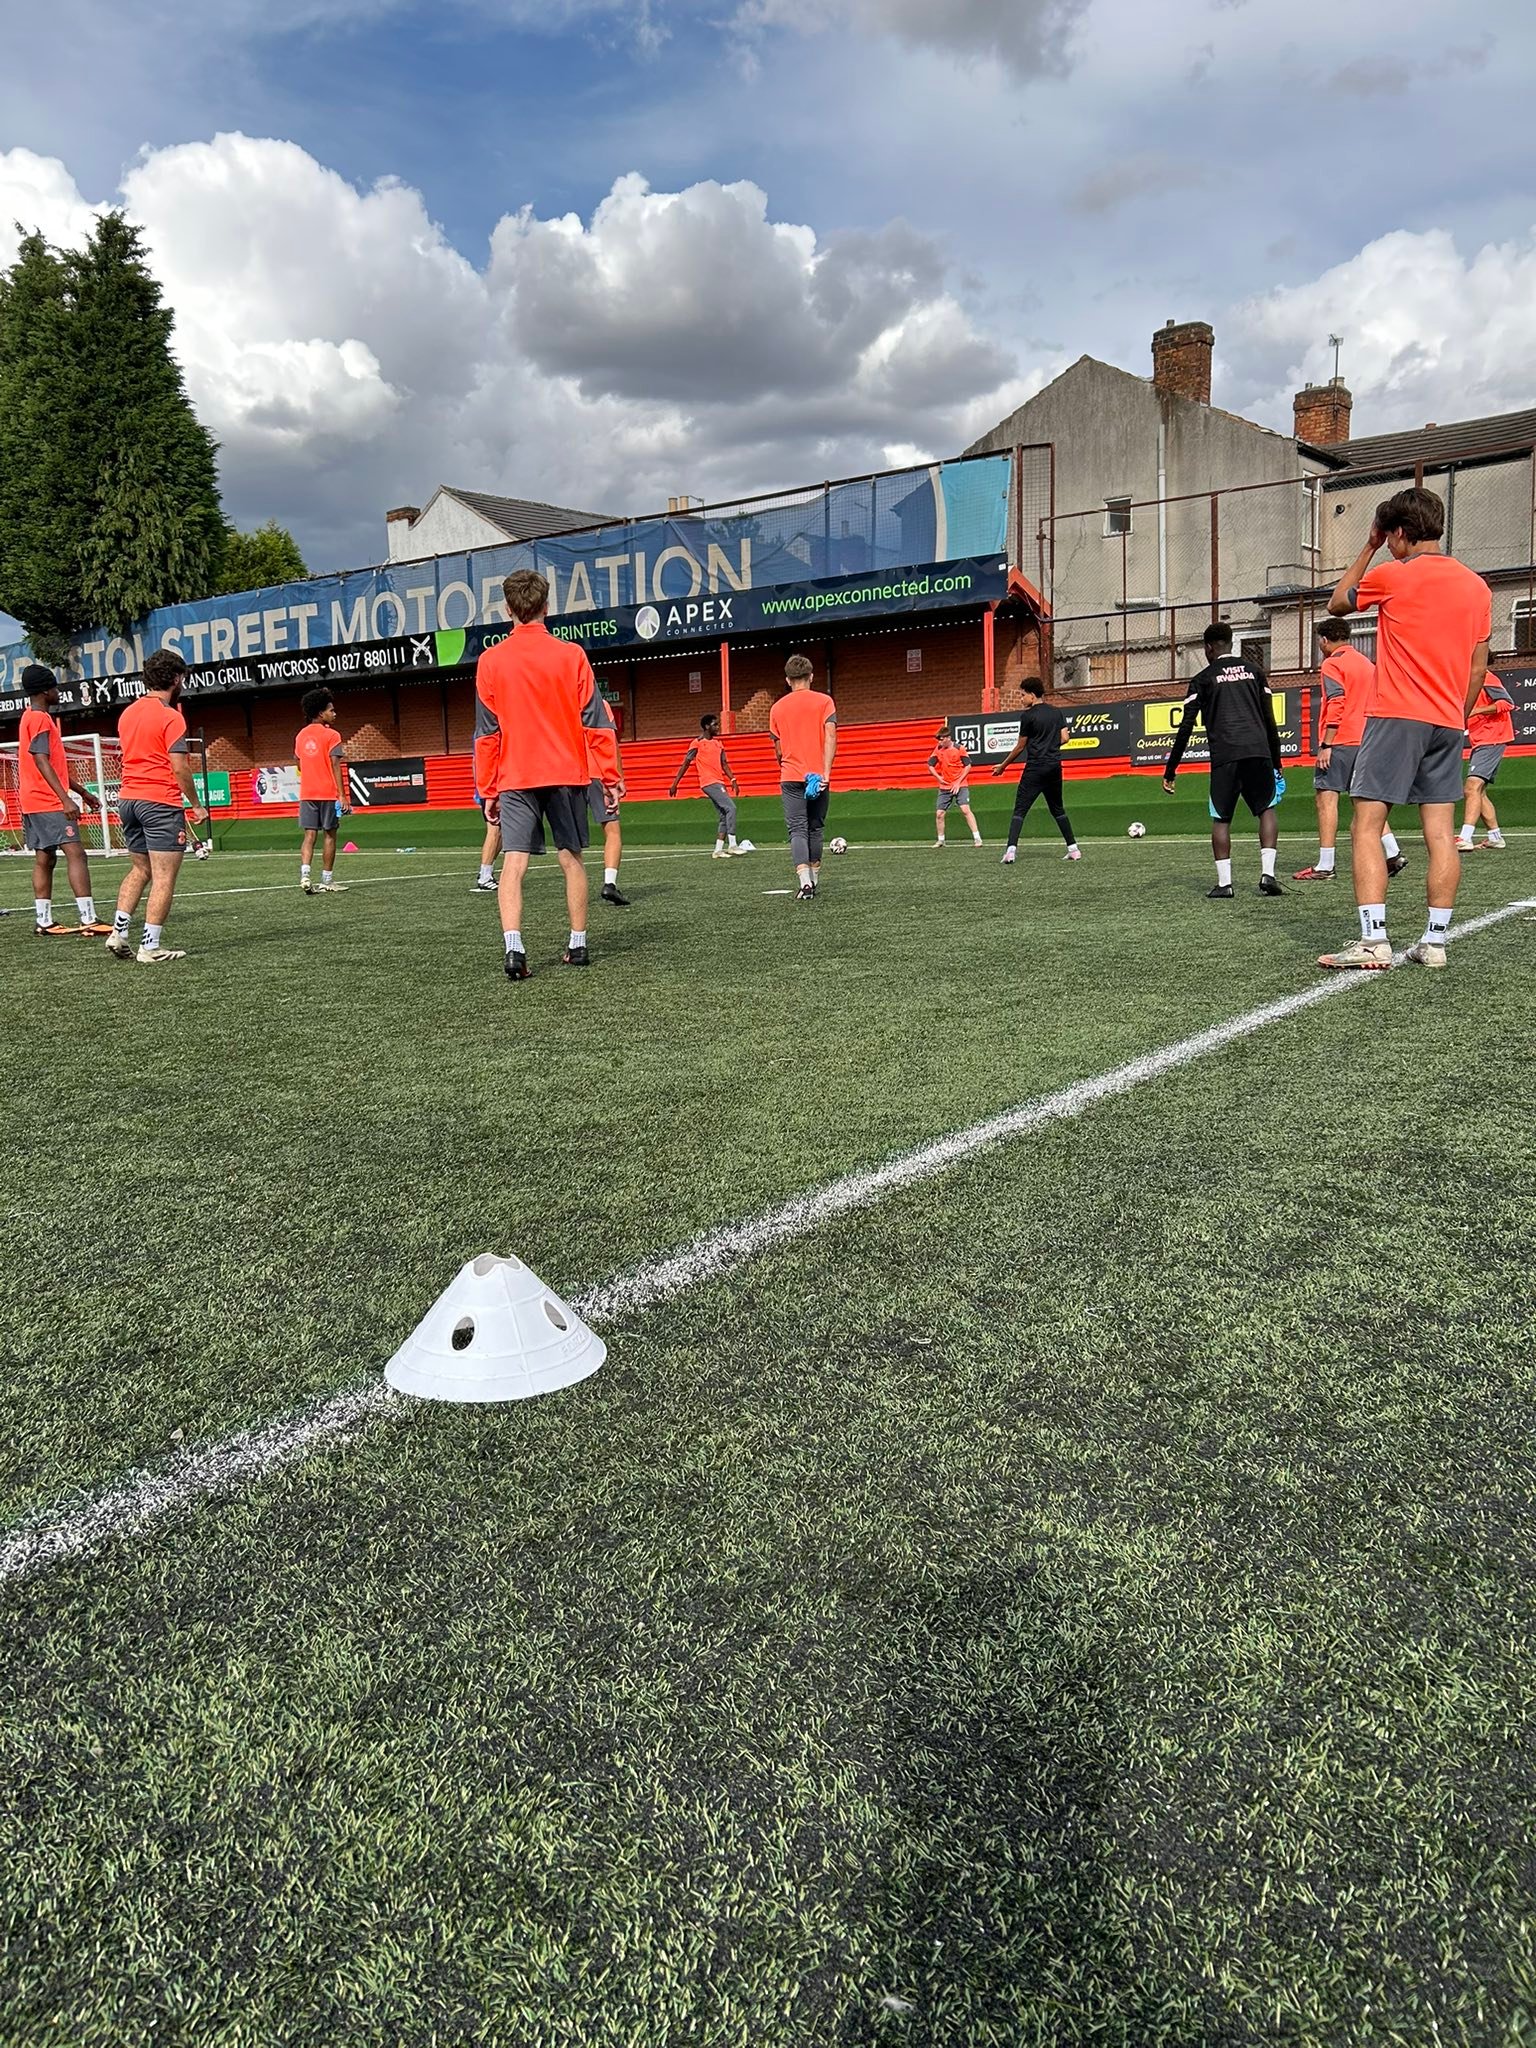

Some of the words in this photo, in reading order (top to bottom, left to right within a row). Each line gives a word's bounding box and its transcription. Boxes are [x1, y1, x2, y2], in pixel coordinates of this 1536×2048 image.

[762, 573, 972, 615] www.apexconnected.com
[666, 598, 733, 626] APEX
[161, 603, 318, 665] STREET
[552, 619, 618, 640] PRINTERS
[666, 621, 734, 636] CONNECTED
[188, 671, 215, 689] AND
[217, 666, 252, 685] GRILL
[257, 657, 319, 680] TWYCROSS
[328, 652, 360, 673] 01827
[364, 646, 406, 668] 880111
[1222, 665, 1247, 675] VISIT
[1215, 672, 1255, 684] RWANDA
[15, 698, 23, 710] BY
[1075, 713, 1113, 729] YOUR
[1080, 723, 1119, 732] SEASON
[1522, 726, 1536, 735] SP
